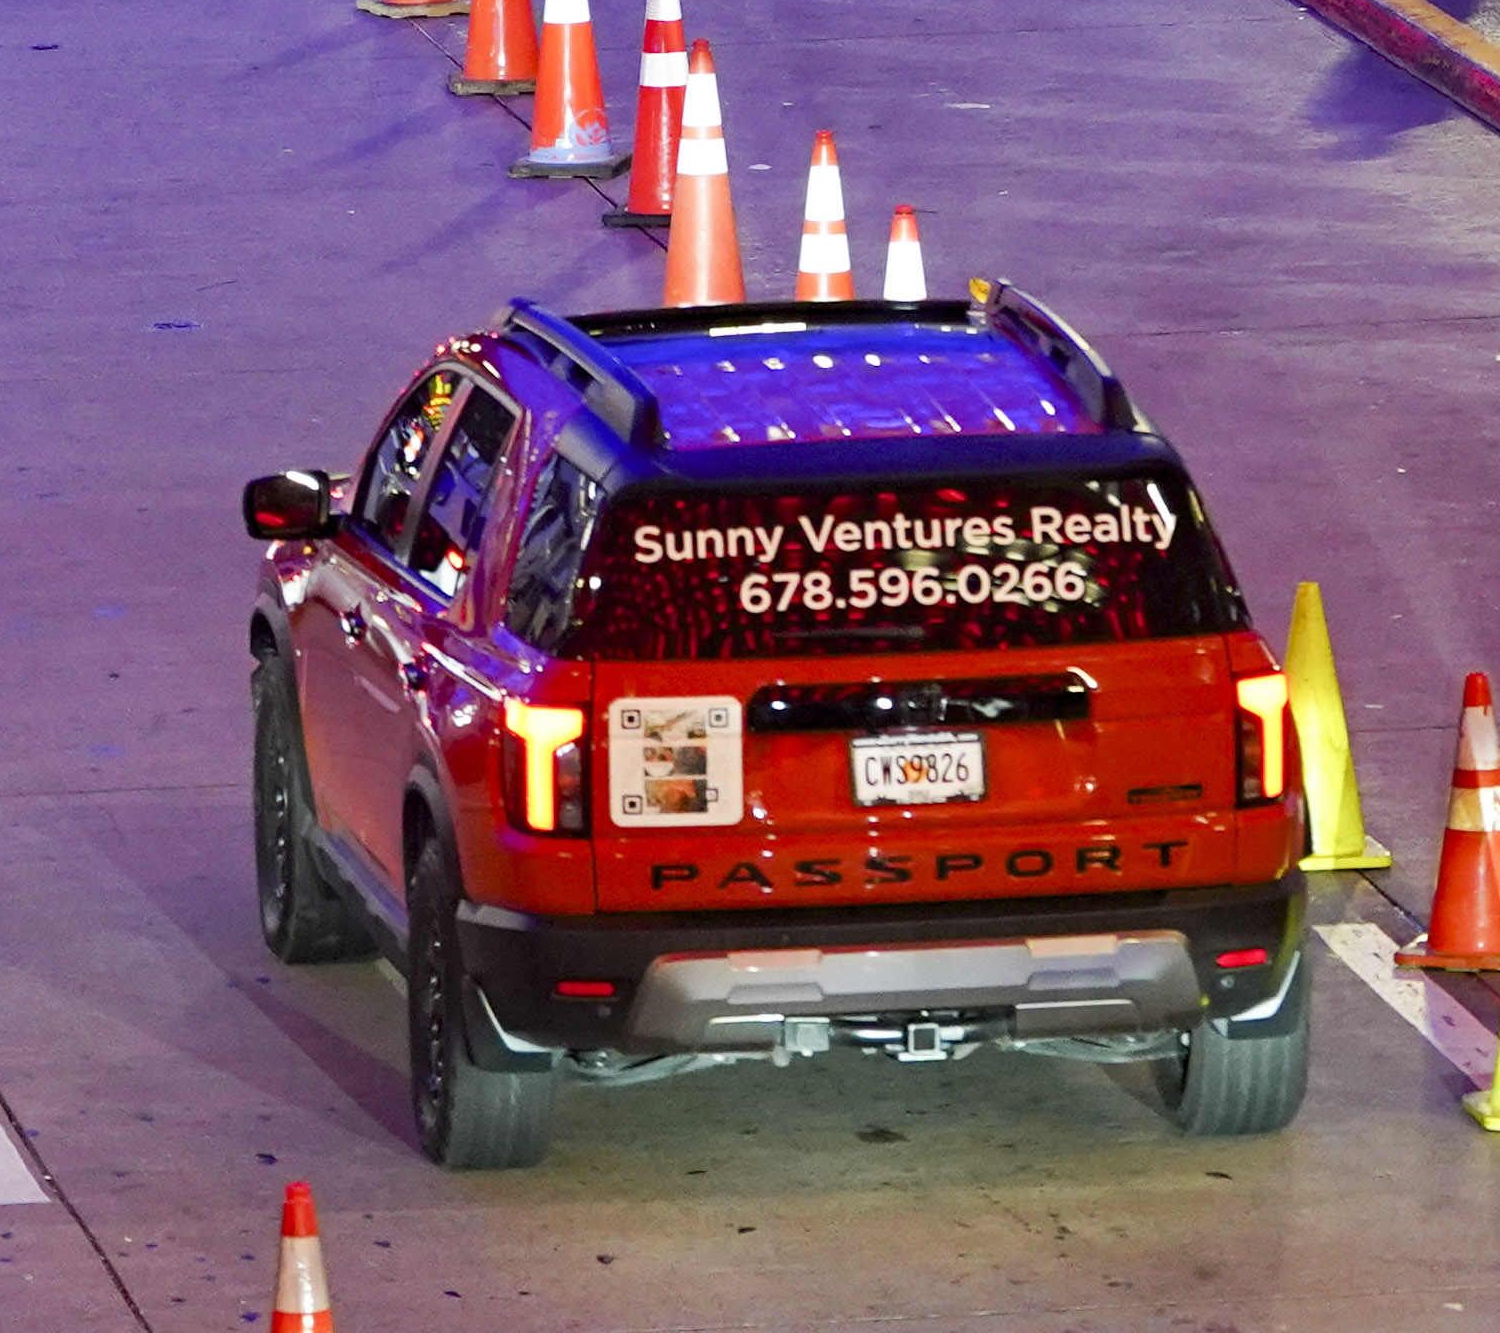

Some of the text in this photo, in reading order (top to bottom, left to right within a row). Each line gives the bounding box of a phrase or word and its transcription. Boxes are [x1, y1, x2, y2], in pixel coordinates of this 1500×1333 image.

[634, 504, 1178, 564] Sunny Ventures Realty
[739, 560, 1088, 614] 678.596.0266
[864, 752, 970, 786] CWS9826
[651, 840, 1190, 892] PASSPORT
